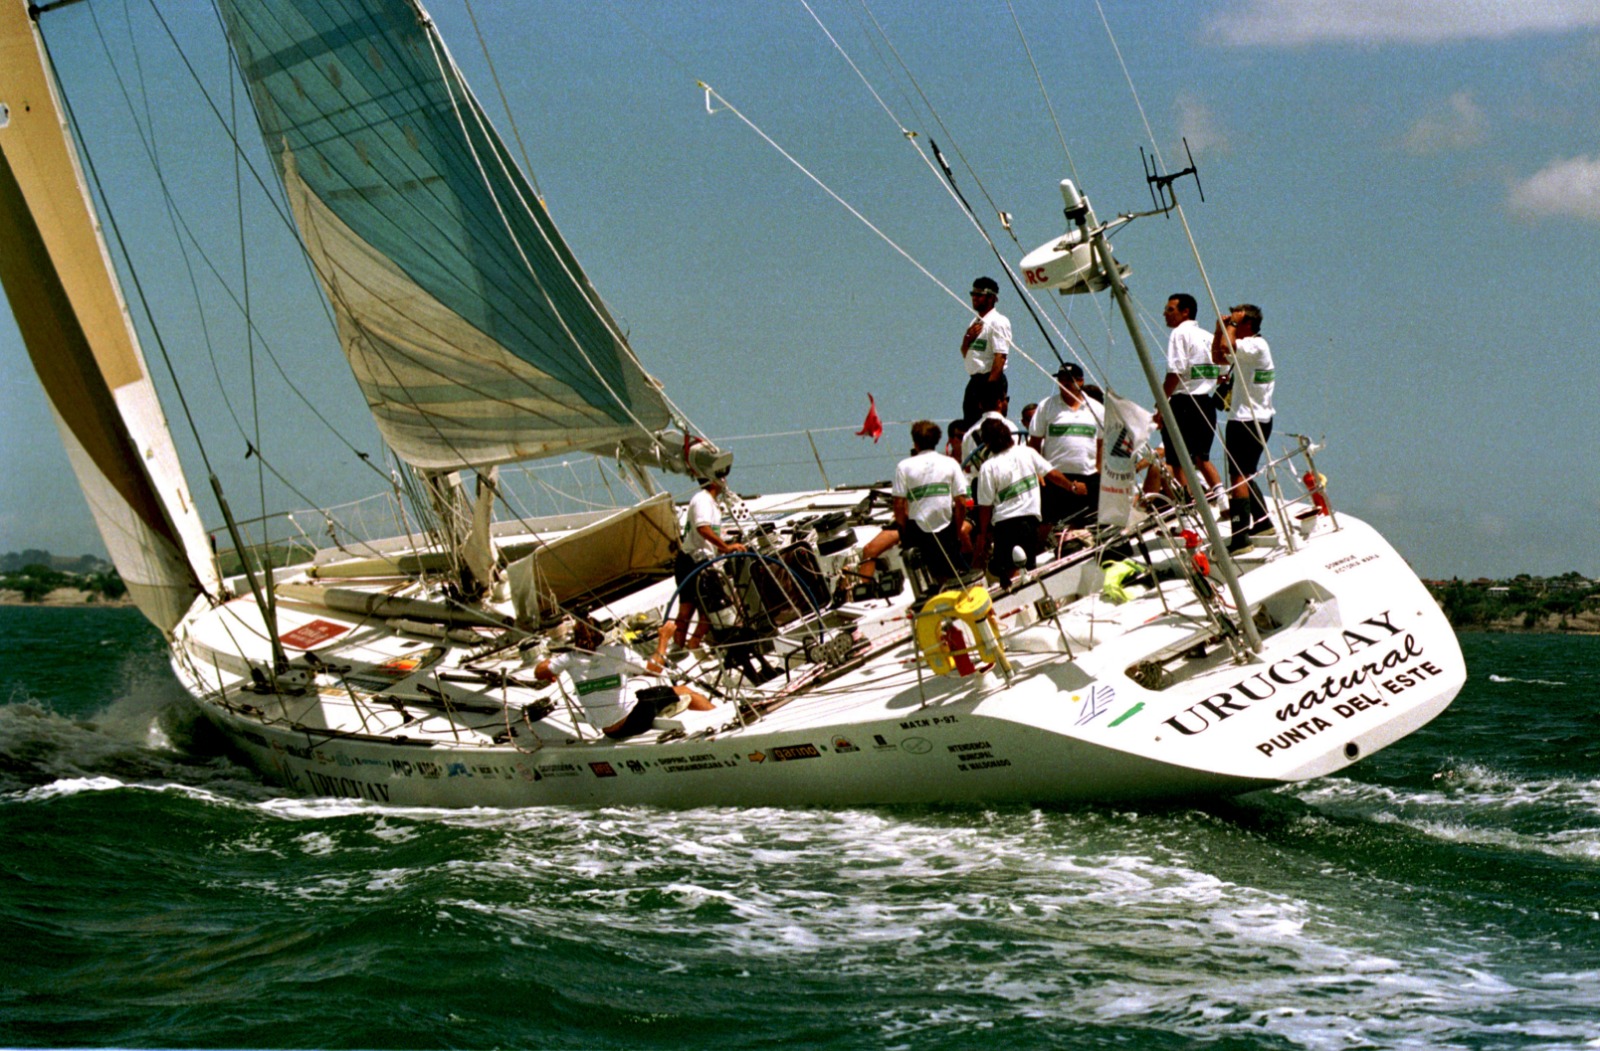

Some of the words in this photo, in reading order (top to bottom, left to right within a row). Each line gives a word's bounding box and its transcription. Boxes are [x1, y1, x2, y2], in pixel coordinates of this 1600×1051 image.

[1162, 610, 1405, 736] URUGUAY
[1255, 717, 1333, 758] PUNTA
[1332, 692, 1381, 719] DEL
[1381, 660, 1443, 695] ESTE
[1275, 633, 1424, 722] natural
